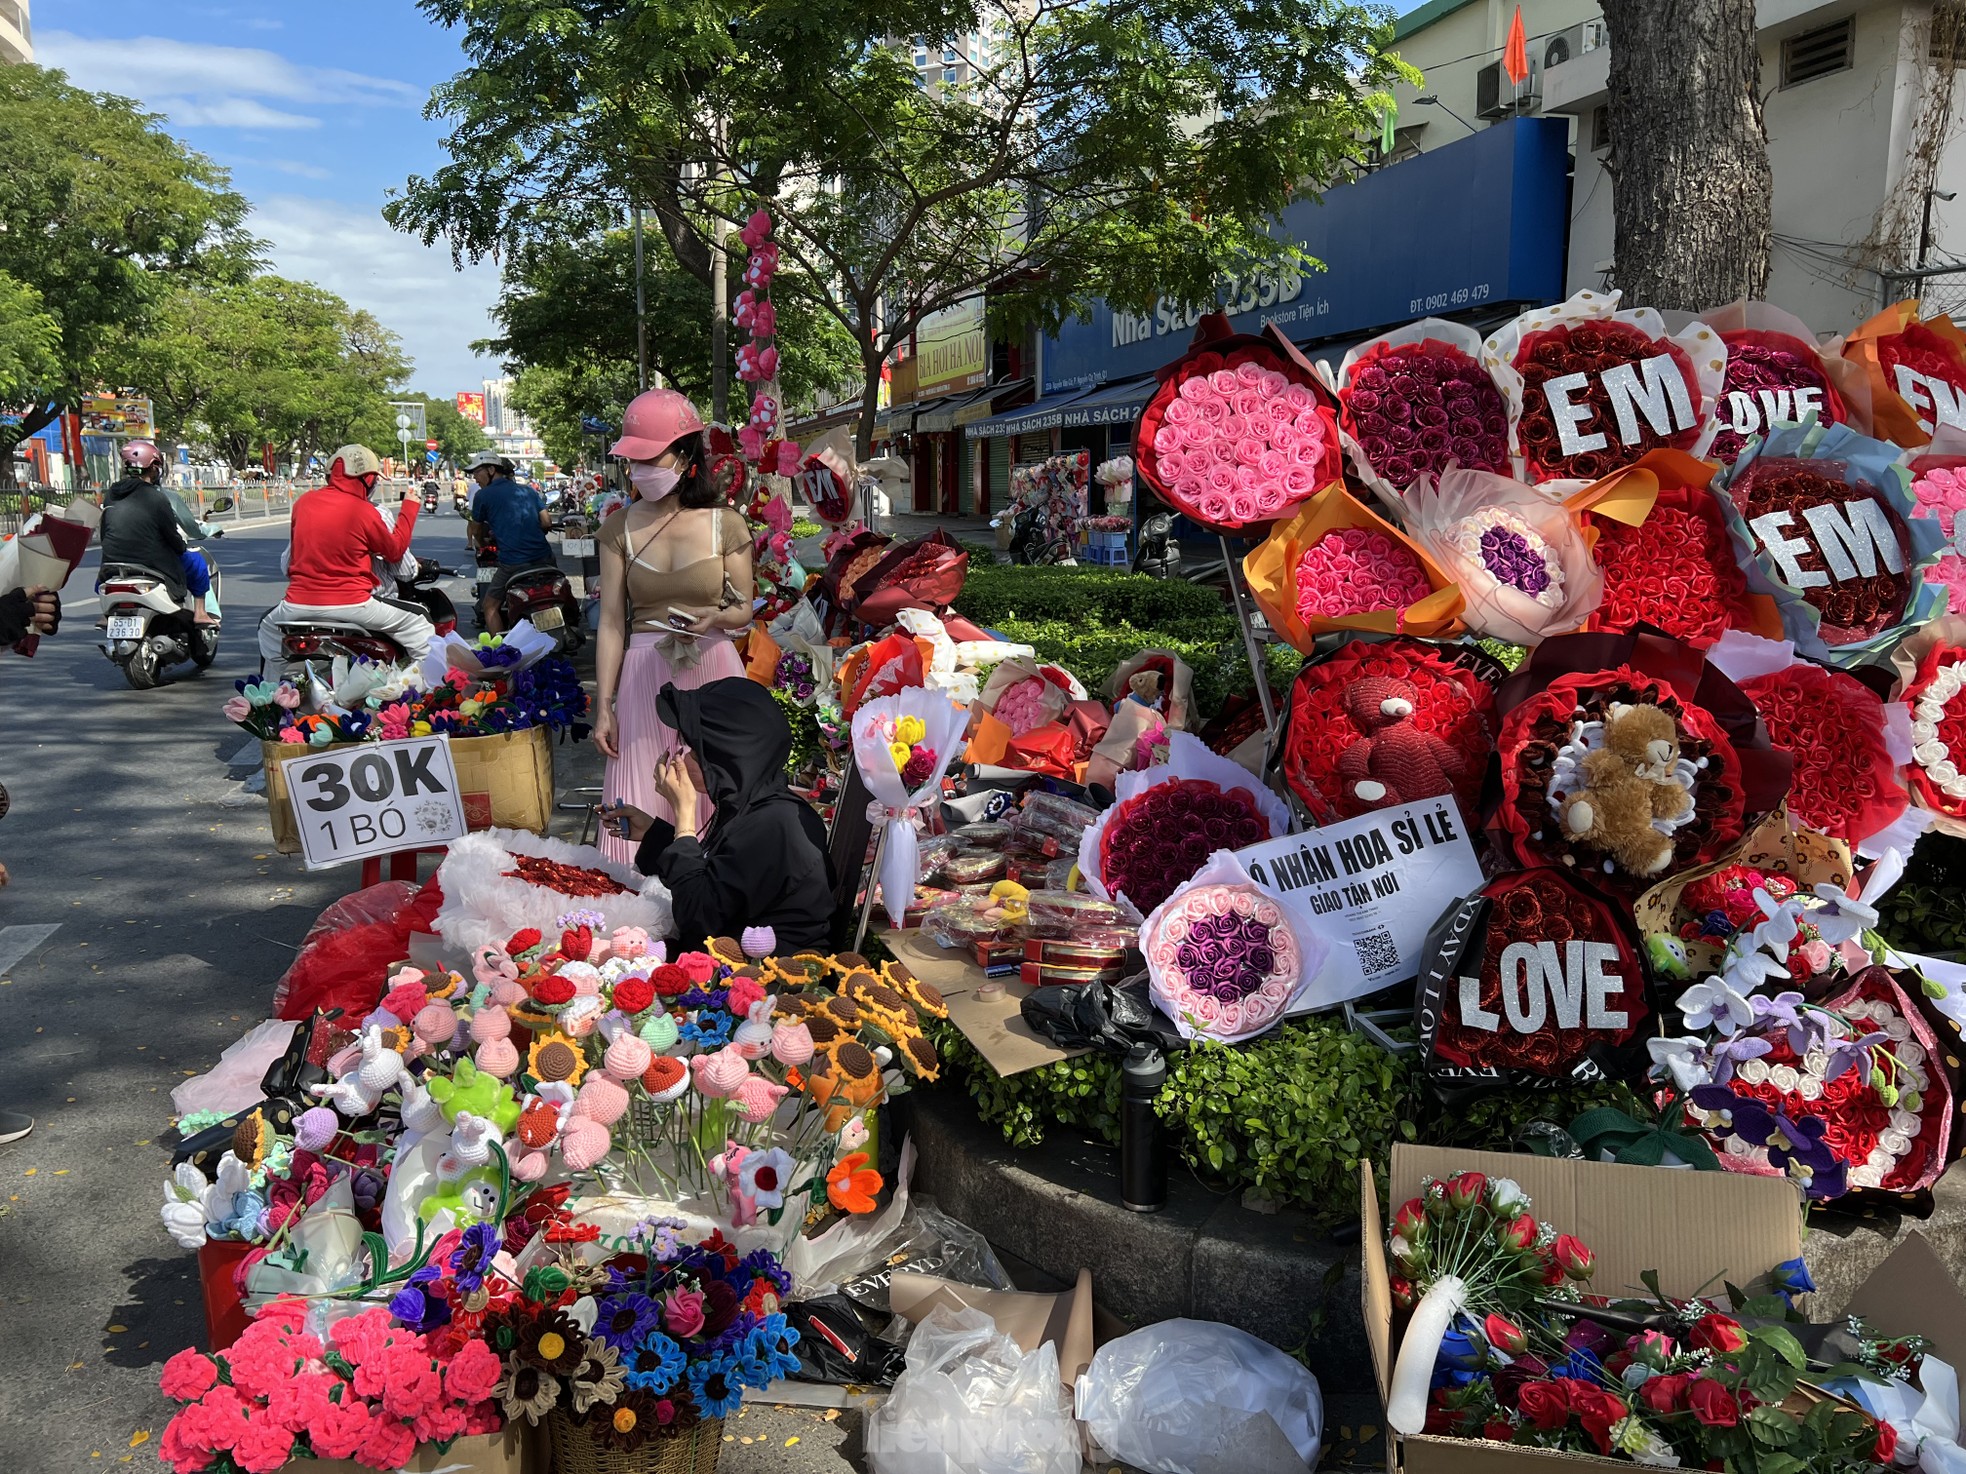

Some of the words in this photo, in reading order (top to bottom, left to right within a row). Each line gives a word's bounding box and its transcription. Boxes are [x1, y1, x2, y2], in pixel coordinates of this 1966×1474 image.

[1260, 310, 1297, 329] Bookstore
[1298, 303, 1315, 322] Tiện
[1316, 296, 1329, 316] Ích
[1410, 298, 1424, 313] ĐT:
[1425, 293, 1448, 310] 0902
[1450, 288, 1469, 305] 469
[1471, 283, 1489, 300] 479
[1006, 420, 1020, 434] NHÀ
[1021, 417, 1041, 431] SÁCH
[1042, 413, 1062, 427] 235B
[1064, 409, 1090, 425] NHÀ
[1093, 407, 1130, 422] SÁCH
[1543, 353, 1697, 456] EM
[1719, 386, 1823, 435] OVE
[965, 424, 978, 437] NHÀ
[978, 423, 995, 436] SÁCH
[1749, 498, 1904, 588] EM
[301, 746, 448, 812] 30K
[320, 820, 338, 850] 1
[349, 800, 406, 846] BÓ
[1244, 857, 1270, 888] Ó
[1269, 843, 1338, 893] NHẬN
[1334, 828, 1394, 876] HOA
[1391, 810, 1424, 856] SỈ
[1423, 803, 1458, 845] LẺ
[1309, 890, 1343, 916] GIAO
[1341, 882, 1373, 909] TẬN
[1459, 940, 1629, 1034] LOVE
